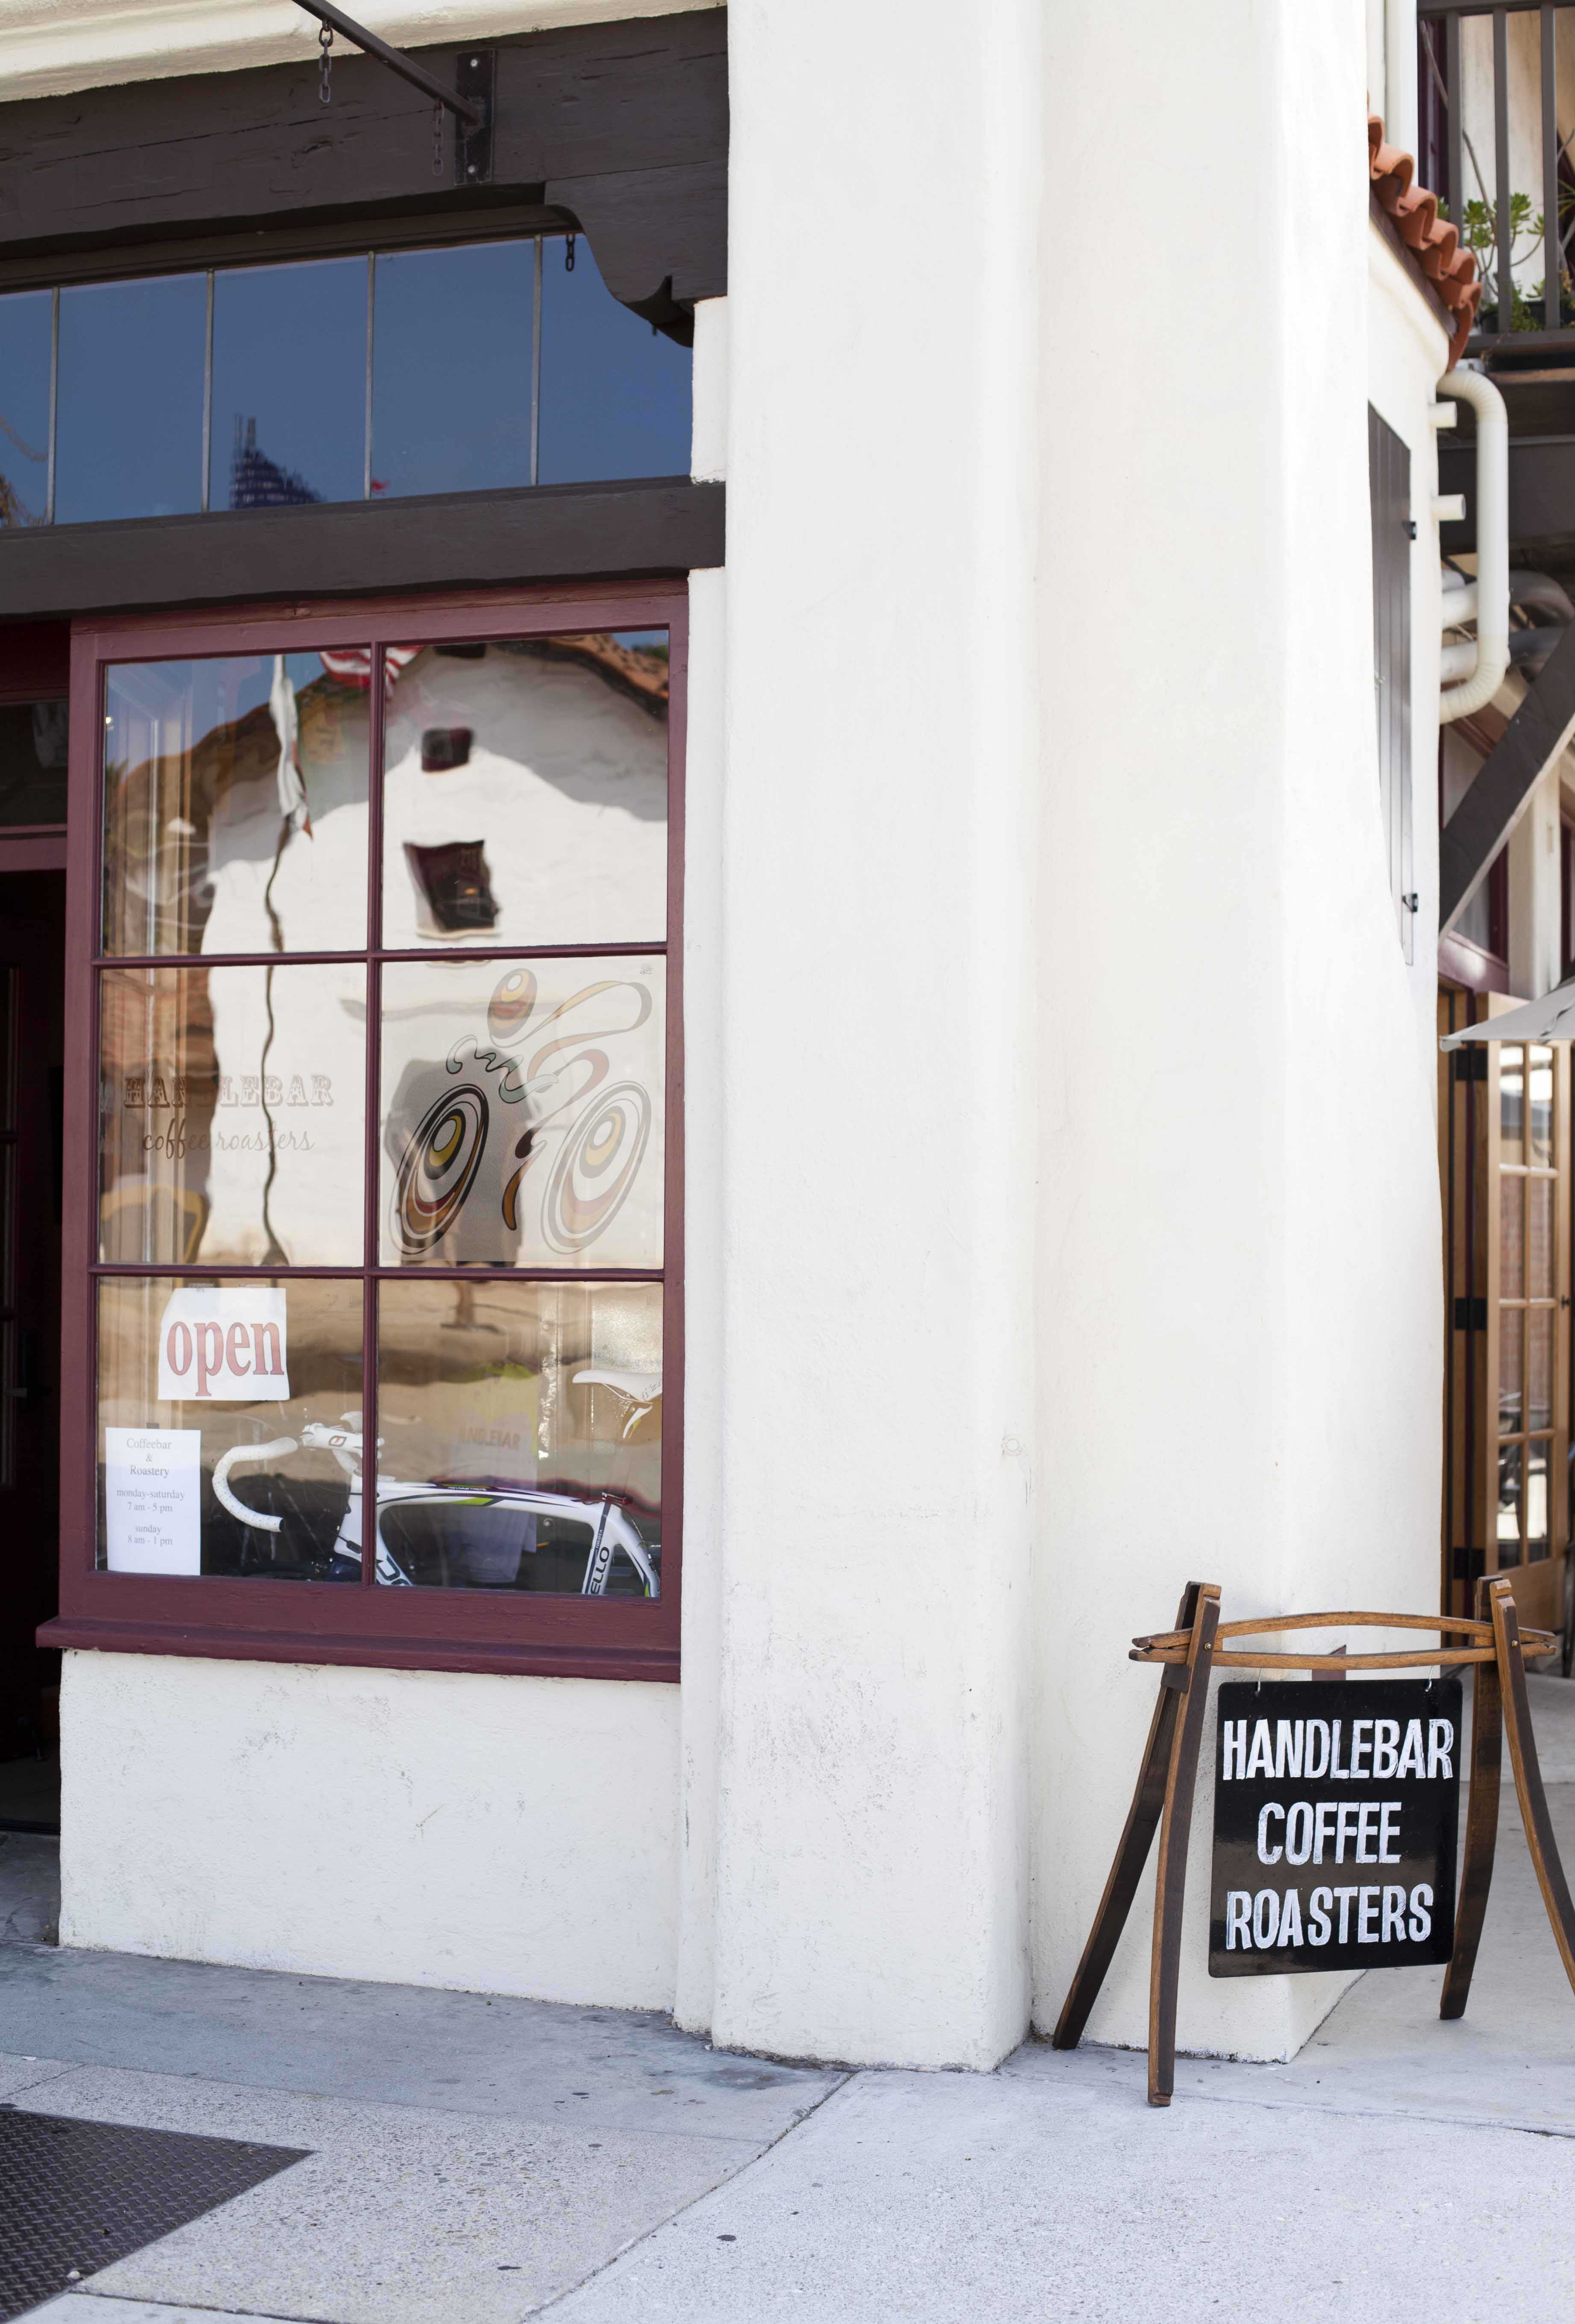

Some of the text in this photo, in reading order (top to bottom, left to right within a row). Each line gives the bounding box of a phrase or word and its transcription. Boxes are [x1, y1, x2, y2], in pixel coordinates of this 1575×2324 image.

[124, 1074, 334, 1108] HANLEBAR
[143, 1118, 315, 1159] coffee roasters
[167, 1321, 284, 1396] open
[127, 1438, 171, 1450] Coffeebar
[130, 1465, 169, 1478] Roastery
[117, 1489, 185, 1501] monday-saturday
[127, 1502, 132, 1511] 7
[153, 1503, 157, 1512] 5
[160, 1505, 173, 1514] pm
[135, 1525, 161, 1535] sunday
[160, 1538, 173, 1547] pm
[1223, 1719, 1454, 1780] HANDLEBAR
[1257, 1802, 1401, 1865] COFFEE
[1226, 1883, 1433, 1949] ROASTERS
